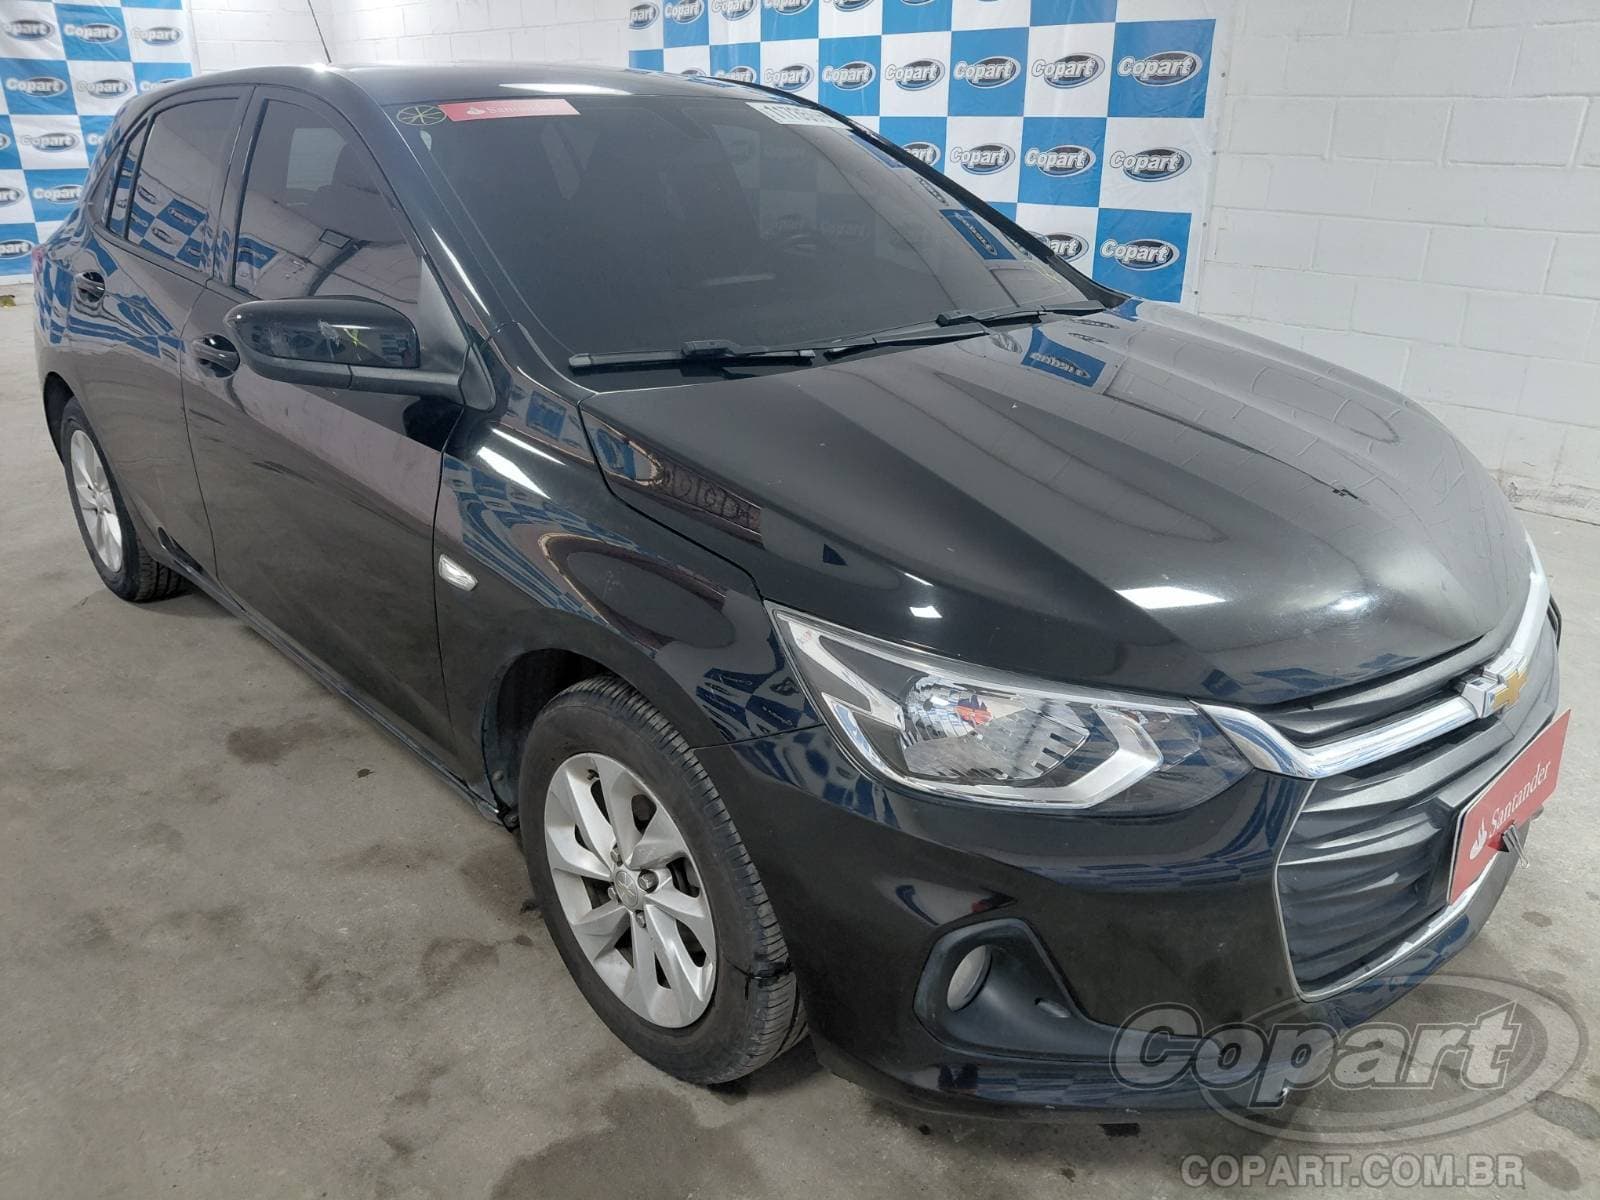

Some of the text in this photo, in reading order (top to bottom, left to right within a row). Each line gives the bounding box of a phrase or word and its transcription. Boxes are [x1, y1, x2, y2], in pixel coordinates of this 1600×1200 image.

[629, 7, 654, 22] part
[664, 2, 700, 21] Copart
[64, 23, 117, 40] Copart
[133, 27, 178, 42] Copart
[764, 67, 808, 88] Copart
[823, 65, 870, 87] Copart
[885, 63, 938, 85] Copart
[953, 60, 1014, 83] Copart
[1031, 56, 1096, 81] Copart
[1117, 55, 1193, 81] Copart
[6, 77, 62, 95] Copart
[78, 79, 126, 95] Copart
[20, 133, 75, 150] Copart
[950, 146, 1008, 169] Copart
[1025, 147, 1088, 172] Copart
[1110, 150, 1181, 175] Copart
[0, 241, 30, 256] part
[1101, 239, 1171, 264] Copart
[1489, 760, 1551, 839] Santander
